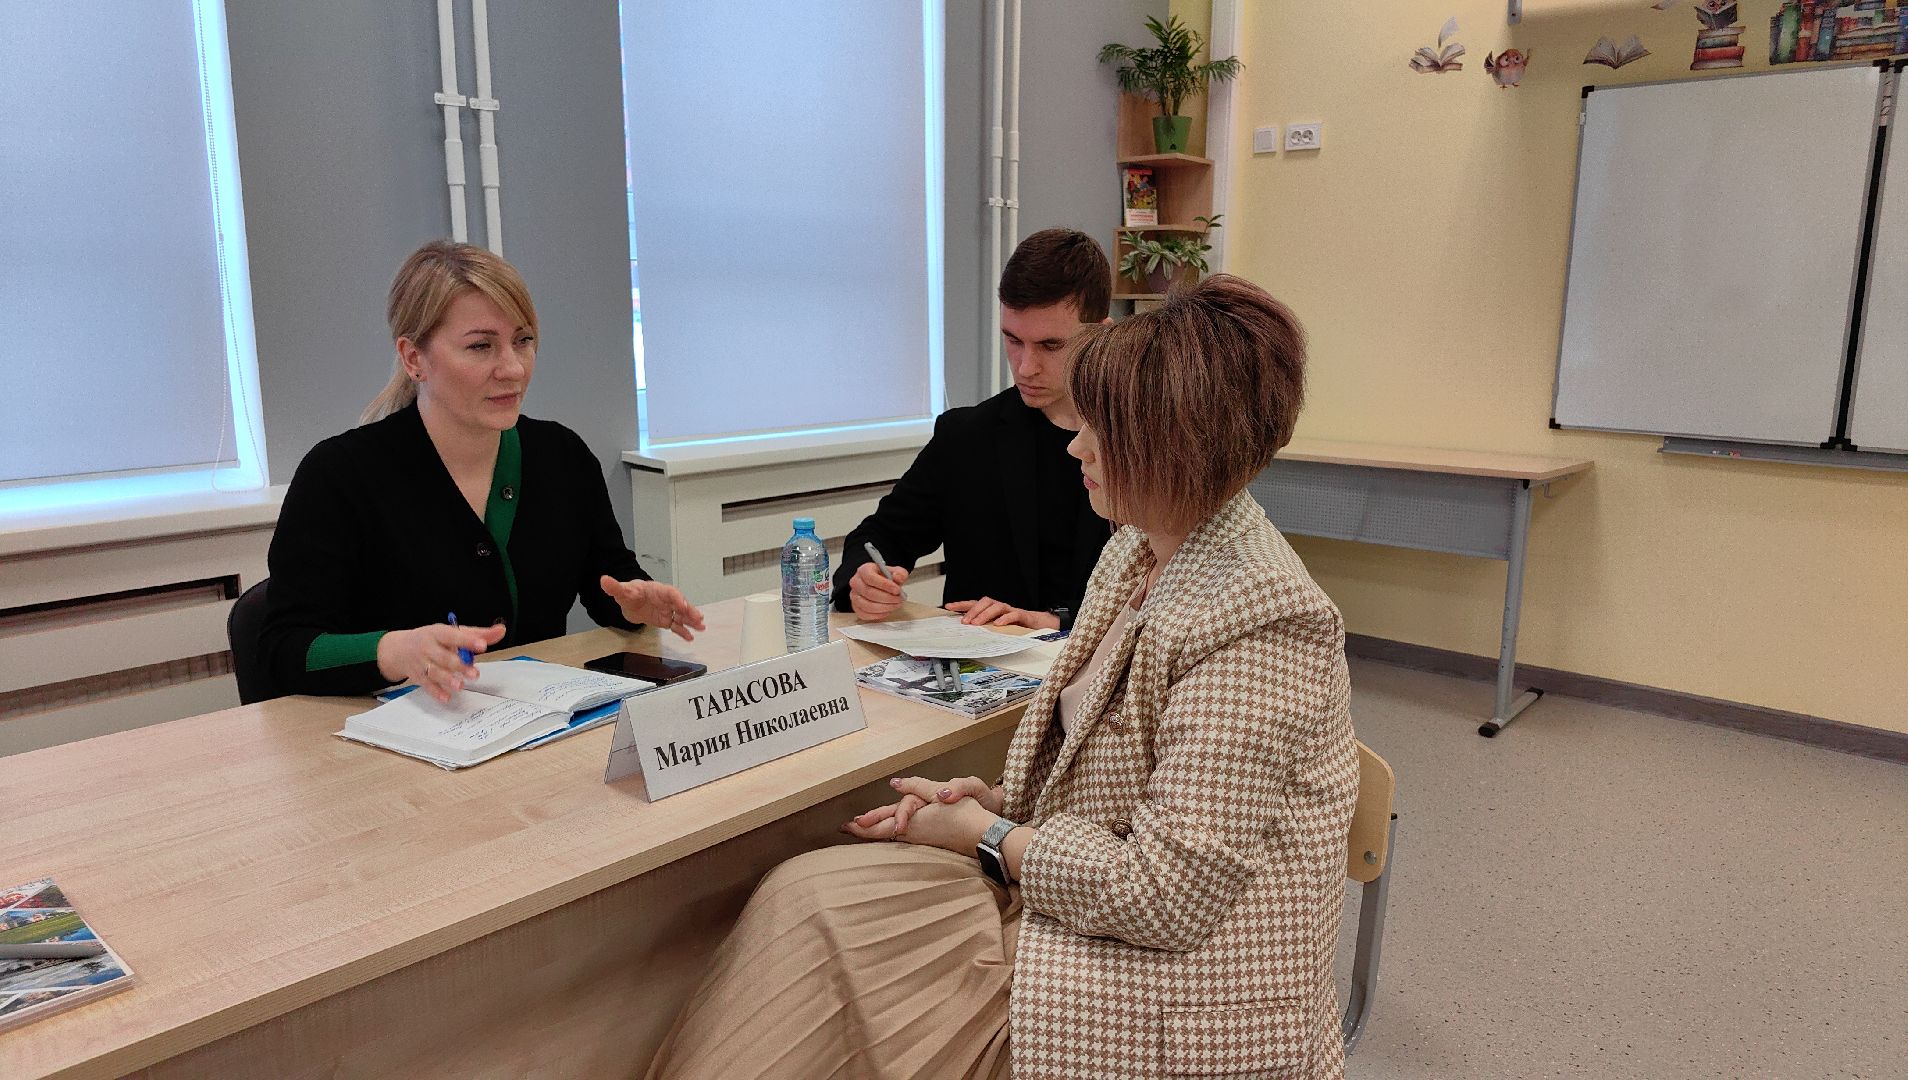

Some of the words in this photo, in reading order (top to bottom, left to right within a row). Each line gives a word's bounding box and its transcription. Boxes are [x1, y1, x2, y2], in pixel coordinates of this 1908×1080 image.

[688, 669, 808, 721] ТАРАСОВА
[654, 730, 732, 771] Мария
[735, 696, 850, 746] Николаевна
